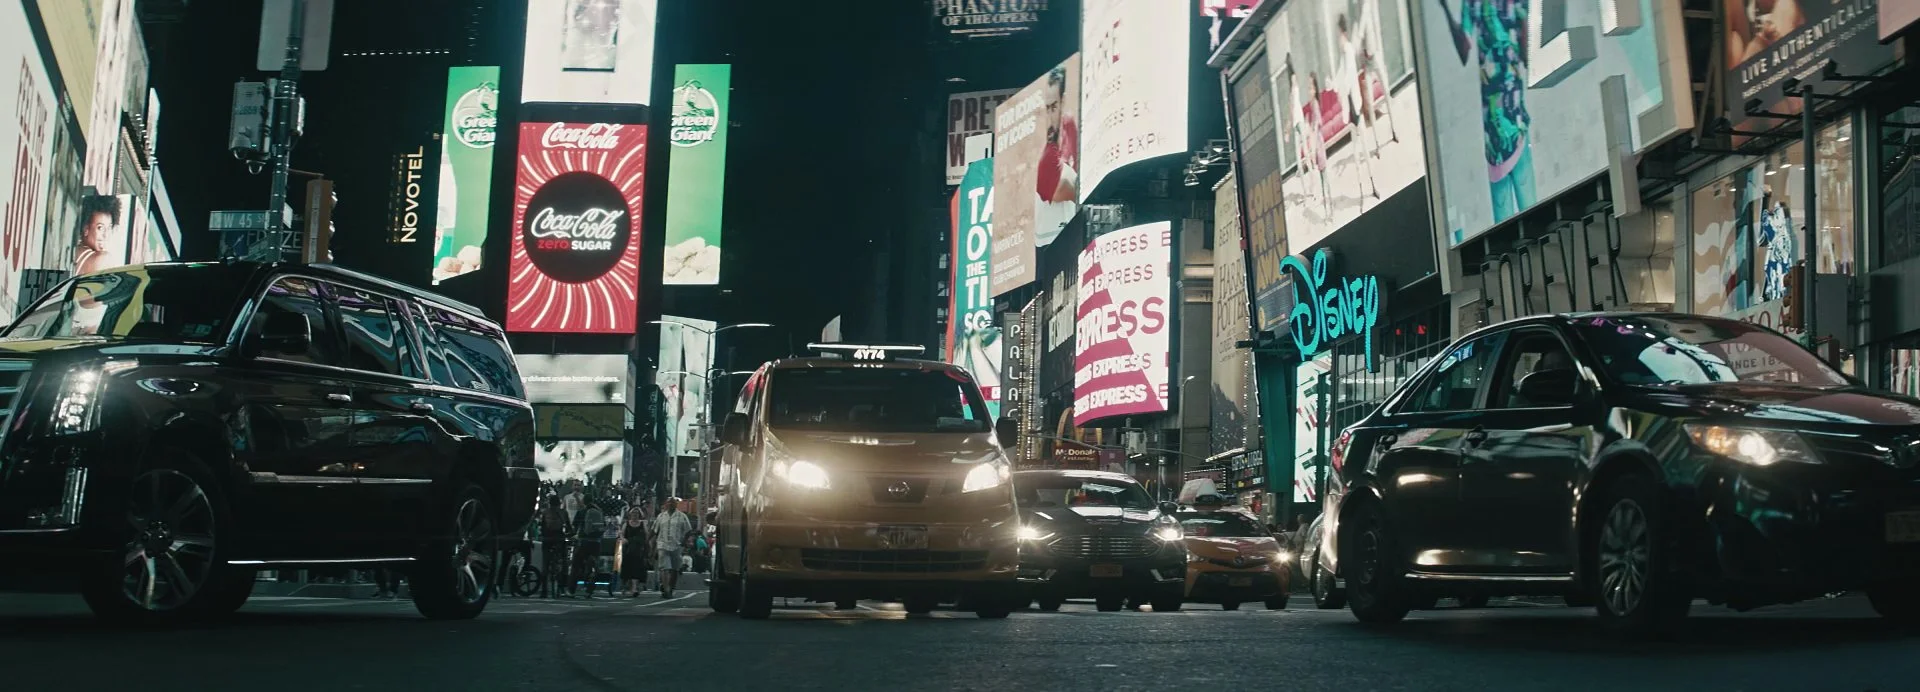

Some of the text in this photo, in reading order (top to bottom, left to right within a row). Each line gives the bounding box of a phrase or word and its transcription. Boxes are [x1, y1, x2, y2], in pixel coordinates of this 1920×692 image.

[942, 12, 1038, 26] OF THE OPERA
[1741, 57, 1768, 84] LIVE
[541, 121, 625, 149] Coca-Cola
[400, 145, 424, 243] NOVOTEL
[224, 214, 234, 228] W
[238, 213, 252, 228] 45
[531, 207, 625, 239] Coca-Cola
[537, 240, 612, 250] zero SUGAR
[1094, 233, 1149, 263] EXPRESS
[965, 261, 987, 278] THE
[1095, 263, 1153, 293] EXPRESS
[1075, 296, 1165, 356] EXPRESS
[853, 349, 885, 360] 4Y74
[1092, 352, 1151, 378] EXPRESS
[1090, 383, 1148, 409] EXPRESS
